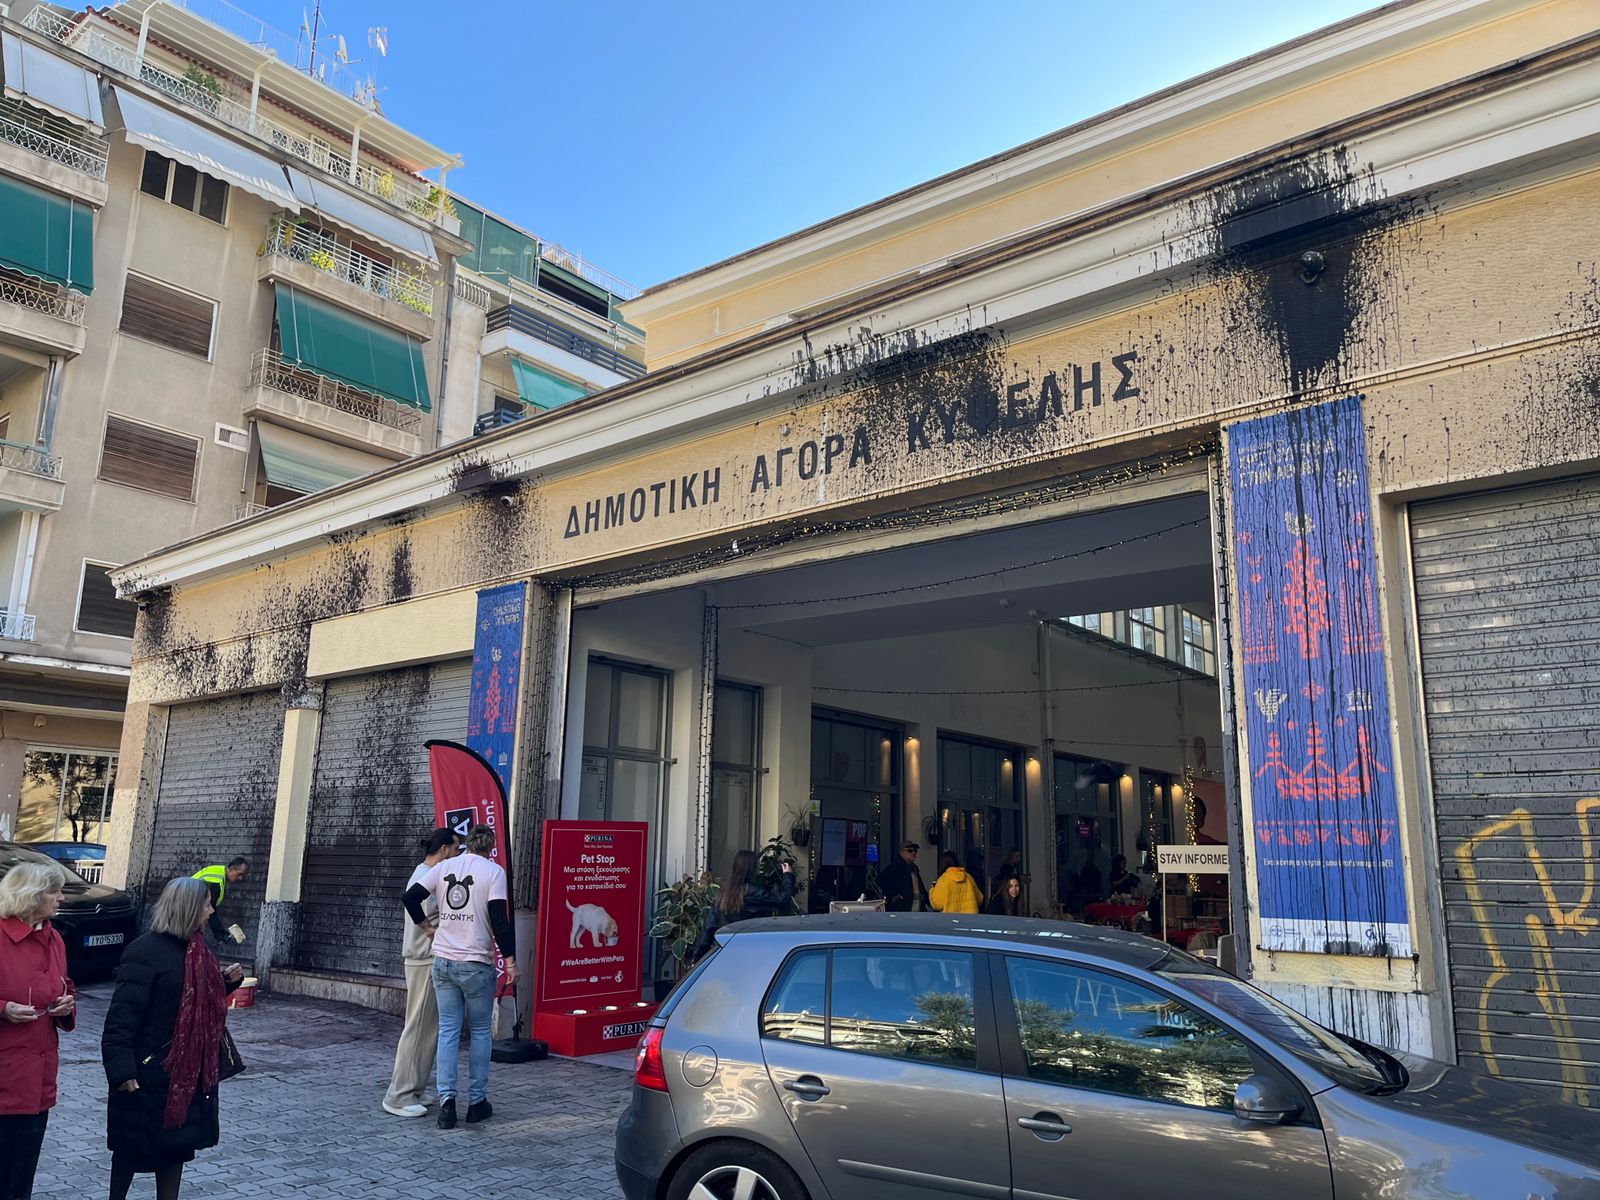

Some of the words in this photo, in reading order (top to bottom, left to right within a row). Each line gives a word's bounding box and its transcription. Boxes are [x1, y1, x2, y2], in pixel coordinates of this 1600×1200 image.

[564, 467, 721, 539] ΔΗΜΟΤΙΚΗ
[750, 425, 873, 494] ΑΓΟΡΑ
[581, 854, 595, 864] Pet
[596, 854, 616, 866] Stop
[1159, 853, 1183, 865] STAY
[1185, 853, 1228, 865] INFORME
[566, 884, 576, 892] για
[560, 955, 625, 967] #WeAreBetterWithPets
[614, 1022, 646, 1036] PURIN
